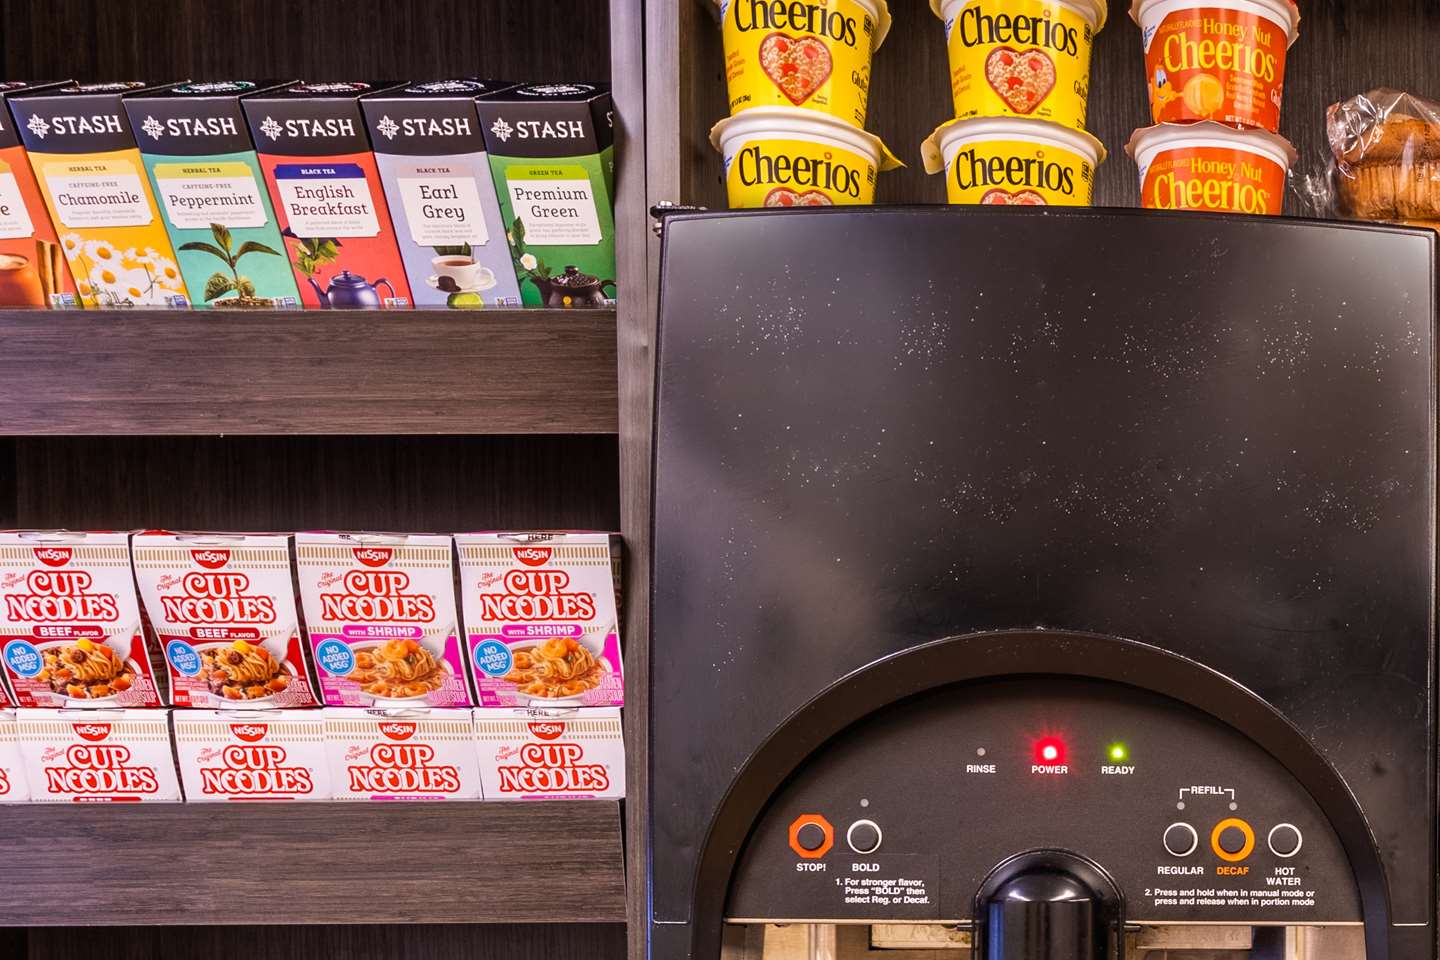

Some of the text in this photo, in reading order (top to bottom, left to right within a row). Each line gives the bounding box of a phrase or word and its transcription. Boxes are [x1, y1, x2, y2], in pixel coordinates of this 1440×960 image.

[735, 0, 857, 47] Cheerios
[960, 6, 1077, 56] Cheerios
[1203, 18, 1271, 47] Honey Nut
[1164, 31, 1275, 82] Cheerios
[52, 115, 123, 135] STASH
[167, 118, 238, 137] STASH
[285, 119, 356, 137] STASH
[403, 118, 472, 136] STASH
[516, 121, 585, 139] STASH
[739, 146, 860, 197] Cheerios
[956, 149, 1074, 195] Cheerios
[1191, 158, 1262, 182] Honey Nut
[58, 191, 140, 206] Chamomile
[294, 185, 355, 201] English
[420, 185, 458, 200] Earl
[514, 187, 588, 201] Premium
[1154, 172, 1267, 214] Cheerios
[169, 194, 255, 209] Peppermint
[291, 203, 369, 216] Breakfast
[422, 205, 465, 221] Grey
[531, 205, 578, 218] Green
[38, 549, 70, 560] NISSIN
[195, 551, 227, 562] NISSIN
[357, 550, 389, 561] NISSIN
[517, 549, 548, 561] NISSIN
[27, 570, 92, 596] CUP
[183, 572, 249, 598] CUP
[344, 570, 409, 596] CUP
[504, 569, 569, 595] CUP
[5, 594, 119, 622] NOODLES
[160, 595, 277, 624] NOODLES
[321, 594, 435, 622] NOODLES
[480, 593, 596, 621] NOODLES
[40, 627, 72, 636] BEEF
[197, 628, 228, 637] BEEF
[367, 626, 415, 636] SHRIMP
[527, 626, 575, 635] SHRIMP
[325, 646, 339, 654] NO
[483, 646, 496, 654] NO
[323, 652, 349, 663] ADDED
[480, 653, 507, 664] ADDED
[76, 725, 108, 736] NISSIN
[234, 725, 265, 736] NISSIN
[383, 724, 413, 735] NISSIN
[532, 724, 562, 735] NISSIN
[66, 745, 130, 770] CUP
[223, 745, 286, 770] CUP
[370, 743, 434, 768] CUP
[520, 743, 583, 768] CUP
[966, 765, 996, 774] RINSE
[1031, 765, 1068, 774] POWER
[1101, 766, 1135, 775] READY
[45, 767, 158, 793] NOODLES
[201, 768, 313, 793] NOODLES
[348, 765, 460, 792] NOODLES
[498, 765, 609, 792] NOODLES
[1190, 786, 1224, 795] REFILL
[796, 863, 826, 872] STOP!
[852, 863, 880, 872] BOLD
[1157, 866, 1204, 876] REGULAR
[1216, 866, 1249, 876] DECAF
[1275, 867, 1295, 876] HOT
[836, 878, 925, 889] 1. For stronger flavor,
[1266, 877, 1301, 886] WATER
[845, 887, 869, 895] Press
[906, 887, 925, 895] then
[1145, 889, 1152, 897] 2.
[1154, 888, 1178, 897] Press
[1179, 888, 1195, 897] and
[1196, 888, 1215, 897] hold
[1216, 888, 1239, 897] when
[1240, 888, 1249, 897] in
[1250, 888, 1279, 897] manual
[1281, 888, 1304, 897] mode
[845, 896, 870, 904] select
[871, 896, 891, 906] Reg.
[903, 896, 930, 904] Decaf.
[1154, 898, 1315, 907] press and release when in portion mode
